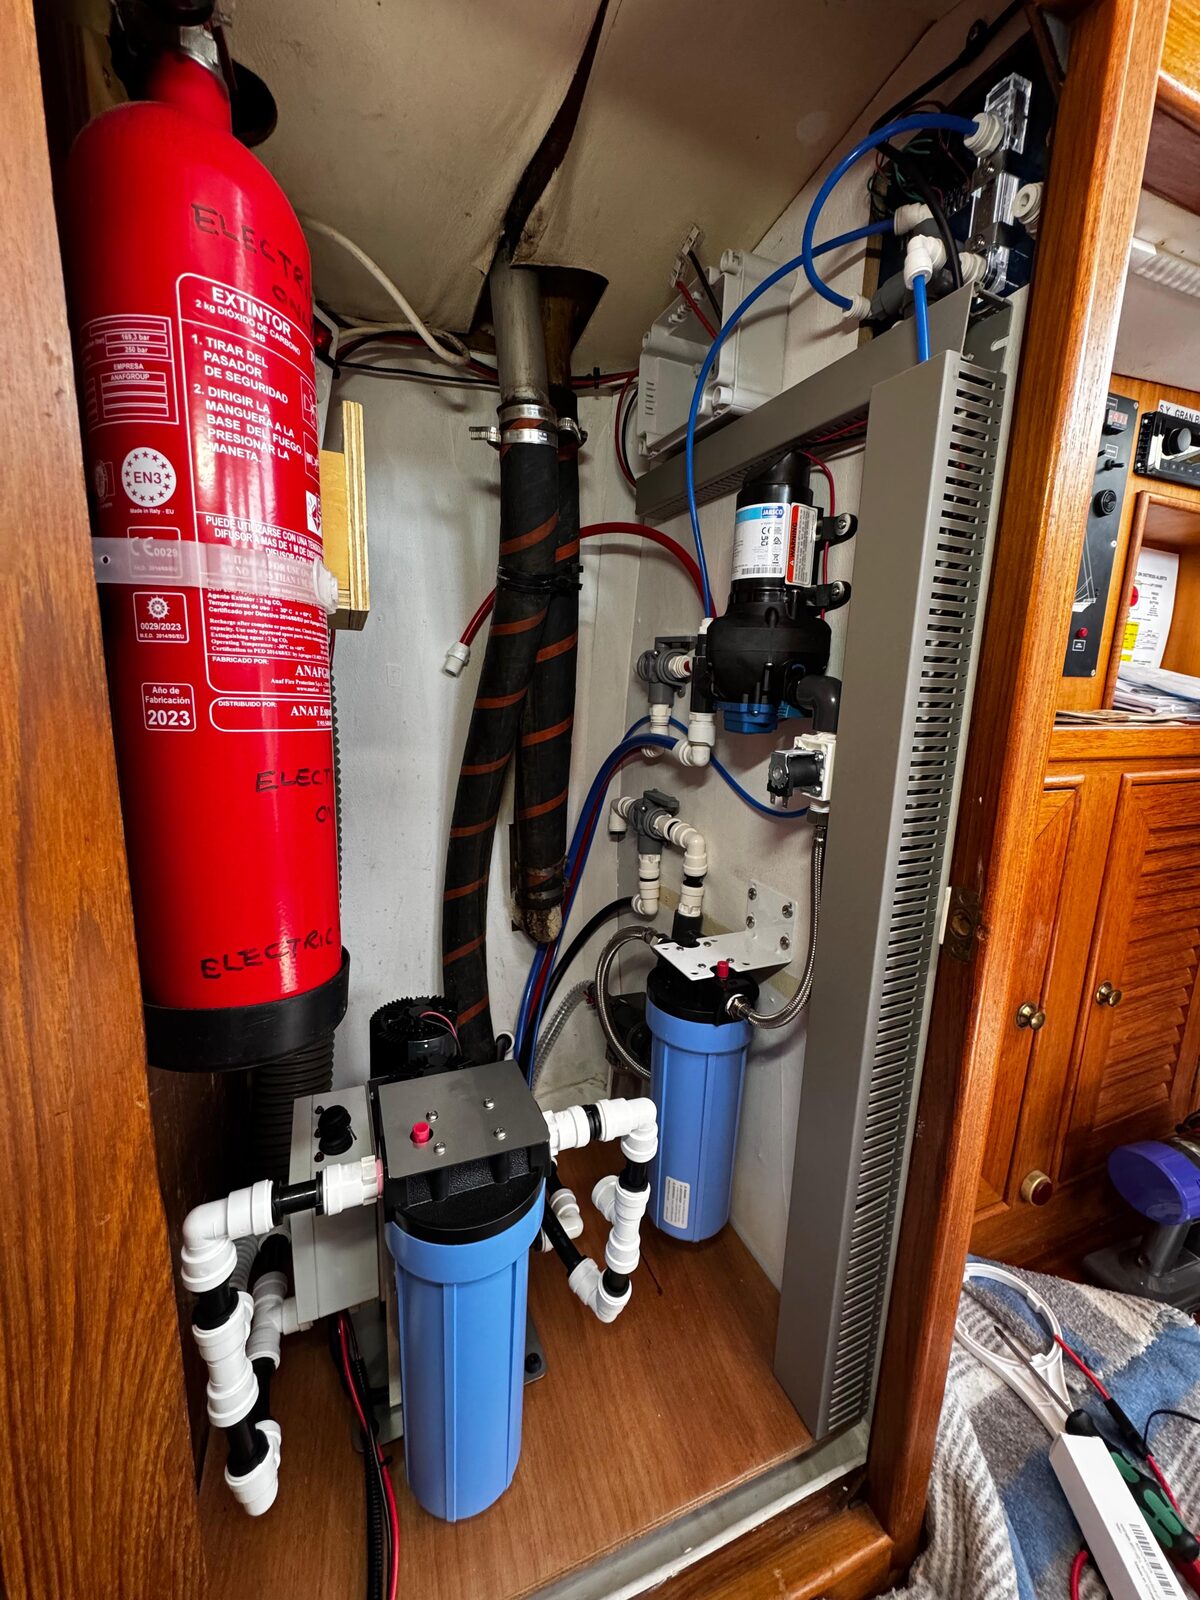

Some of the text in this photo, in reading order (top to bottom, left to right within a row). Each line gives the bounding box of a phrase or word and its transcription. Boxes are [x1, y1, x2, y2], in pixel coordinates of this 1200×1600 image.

[211, 286, 292, 338] EXTINTOR
[195, 299, 202, 309] 2
[203, 301, 216, 314] kg
[257, 321, 269, 335] DE
[269, 328, 301, 356] CARBONO
[139, 333, 150, 341] bar
[250, 330, 266, 343] 34B
[191, 334, 268, 369] 1. TIRAR DEL
[113, 363, 144, 371] EMPRESA
[203, 351, 262, 379] PASADOR
[110, 373, 150, 381] ANAFGROUP
[204, 365, 289, 404] DE SEGURIDAD
[193, 384, 271, 415] 2. DIRIGIR LA
[205, 400, 295, 439] MANGUERA A LA
[206, 414, 304, 457] BASE DEL FUEGO.
[207, 428, 290, 461] PRESIONAR LA
[208, 442, 262, 463] MANETA.
[133, 471, 163, 485] EN3
[762, 508, 783, 516] JABSCO
[205, 515, 236, 529] PUEDE
[282, 531, 296, 543] CON
[296, 535, 308, 547] UNA
[214, 528, 253, 543] DIFUSOR
[278, 540, 288, 551] DE
[299, 546, 307, 557] DE
[154, 548, 178, 558] 0029
[207, 592, 230, 600] Agente
[231, 594, 256, 602] Extintor
[208, 599, 250, 609] Temperaturas
[208, 606, 243, 615] Certificado
[255, 610, 279, 619] Directiva
[140, 622, 182, 631] 0029/2023
[209, 618, 236, 626] Recharge
[236, 619, 250, 627] after
[251, 621, 273, 629] complete
[210, 632, 248, 641] Extinguishing
[246, 627, 258, 635] only
[259, 629, 281, 637] approved
[210, 639, 240, 647] Operating
[241, 640, 273, 648] Temperature
[211, 645, 246, 653] Certification
[212, 656, 269, 665] FABRICADO POR:
[152, 685, 180, 694] Año de
[145, 696, 191, 705] Fabricación
[290, 705, 319, 716] ANAF
[147, 709, 191, 726] 2023
[200, 928, 333, 979] ELECTRIC
